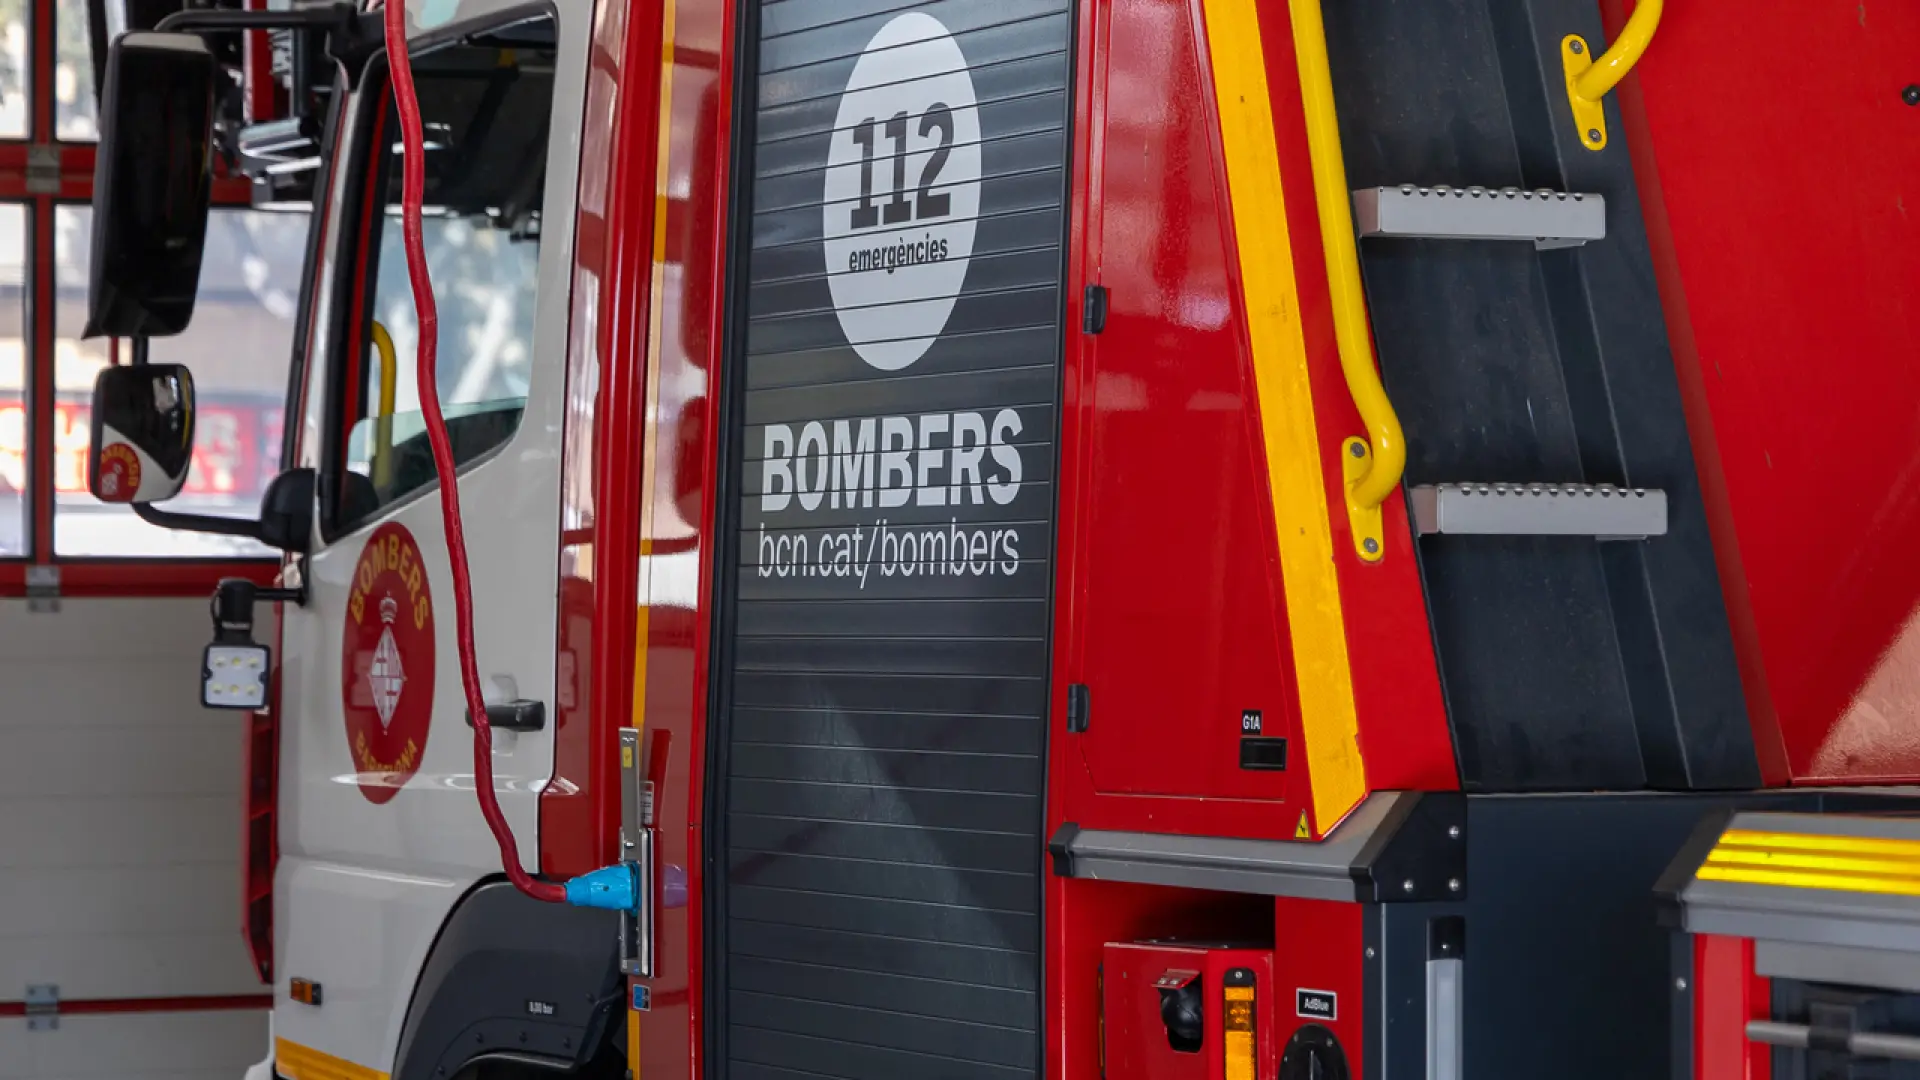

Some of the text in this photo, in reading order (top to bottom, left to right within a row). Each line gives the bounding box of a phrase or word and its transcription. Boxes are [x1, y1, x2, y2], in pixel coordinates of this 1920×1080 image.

[850, 101, 955, 230] 112
[849, 232, 948, 274] emergències
[761, 408, 1024, 512] BOMBERS
[350, 533, 429, 630] BOMBERS
[758, 516, 1020, 591] bcn.cat/bombers
[1242, 713, 1261, 730] G1A
[1304, 996, 1330, 1012] AdBlue
